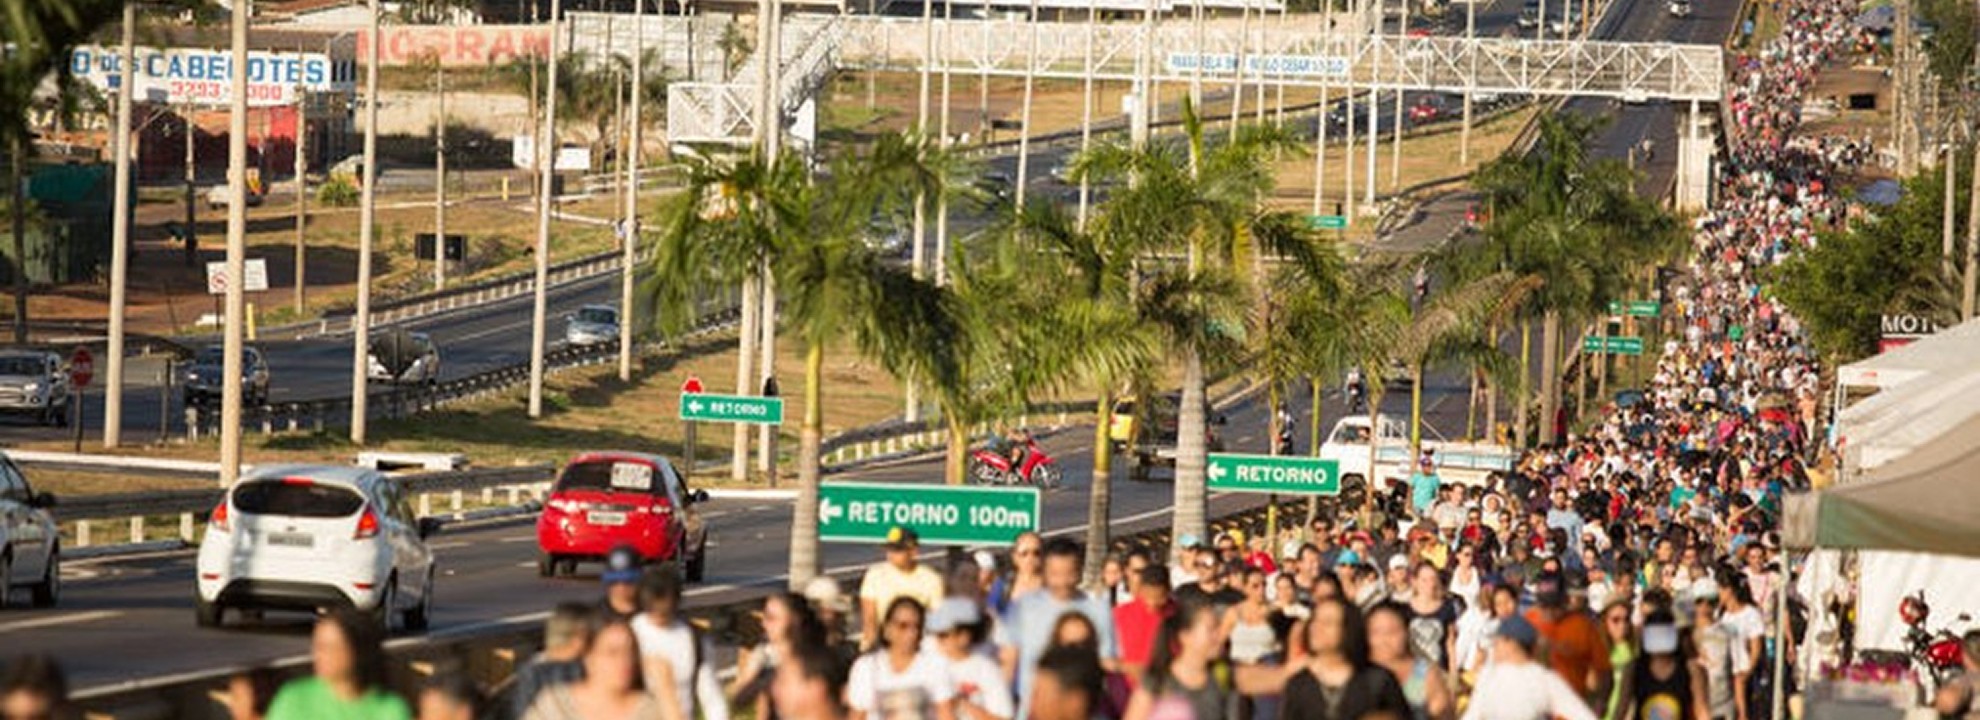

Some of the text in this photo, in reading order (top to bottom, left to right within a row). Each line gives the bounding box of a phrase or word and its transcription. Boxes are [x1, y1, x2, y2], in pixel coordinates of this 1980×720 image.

[710, 401, 767, 417] RETORNO
[1236, 464, 1328, 485] RETORNO
[848, 500, 1031, 529] RETORNO 100m
